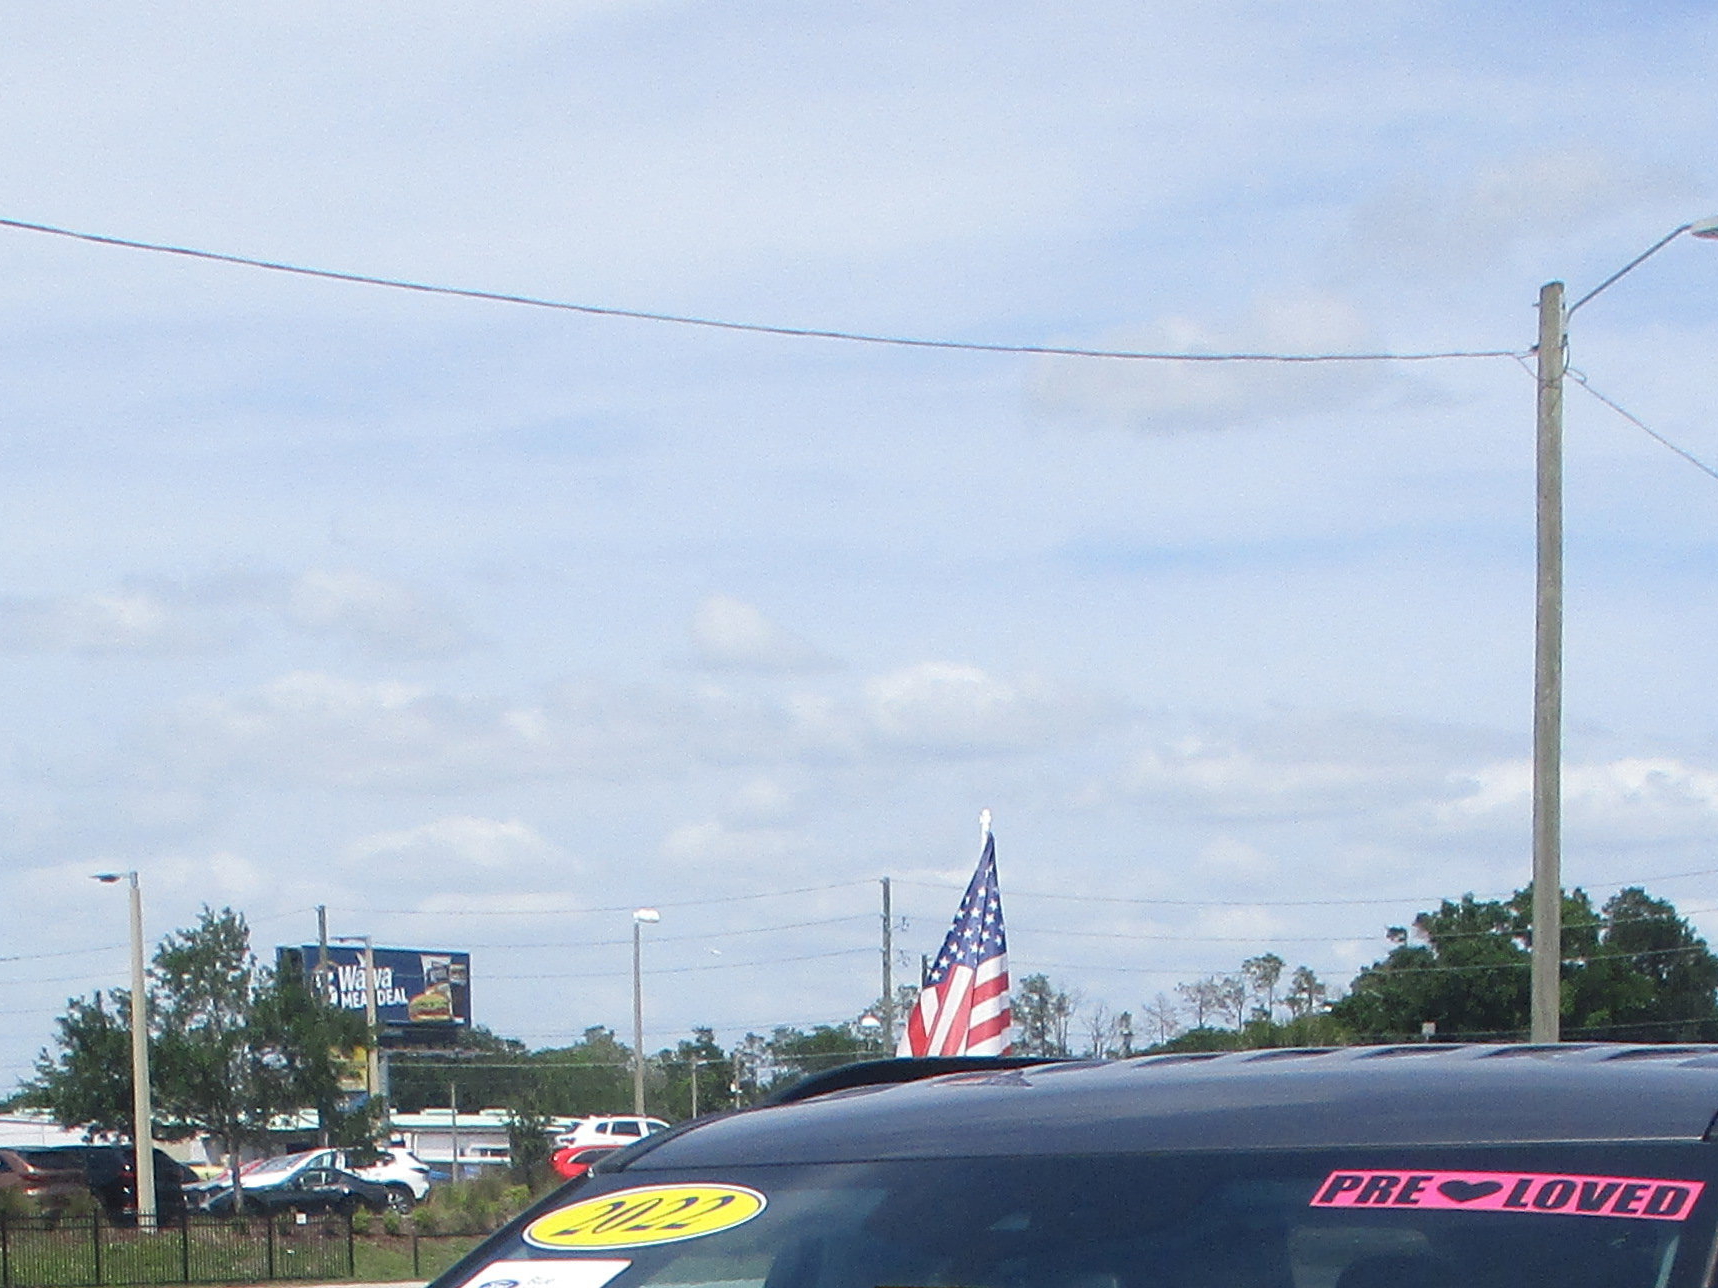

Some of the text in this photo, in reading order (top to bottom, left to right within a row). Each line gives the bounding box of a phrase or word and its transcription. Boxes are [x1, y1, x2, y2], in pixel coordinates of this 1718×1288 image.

[341, 987, 408, 1010] MEA DEAL
[550, 1194, 737, 1238] 2022
[1318, 1174, 1692, 1217] PRE LOVED
